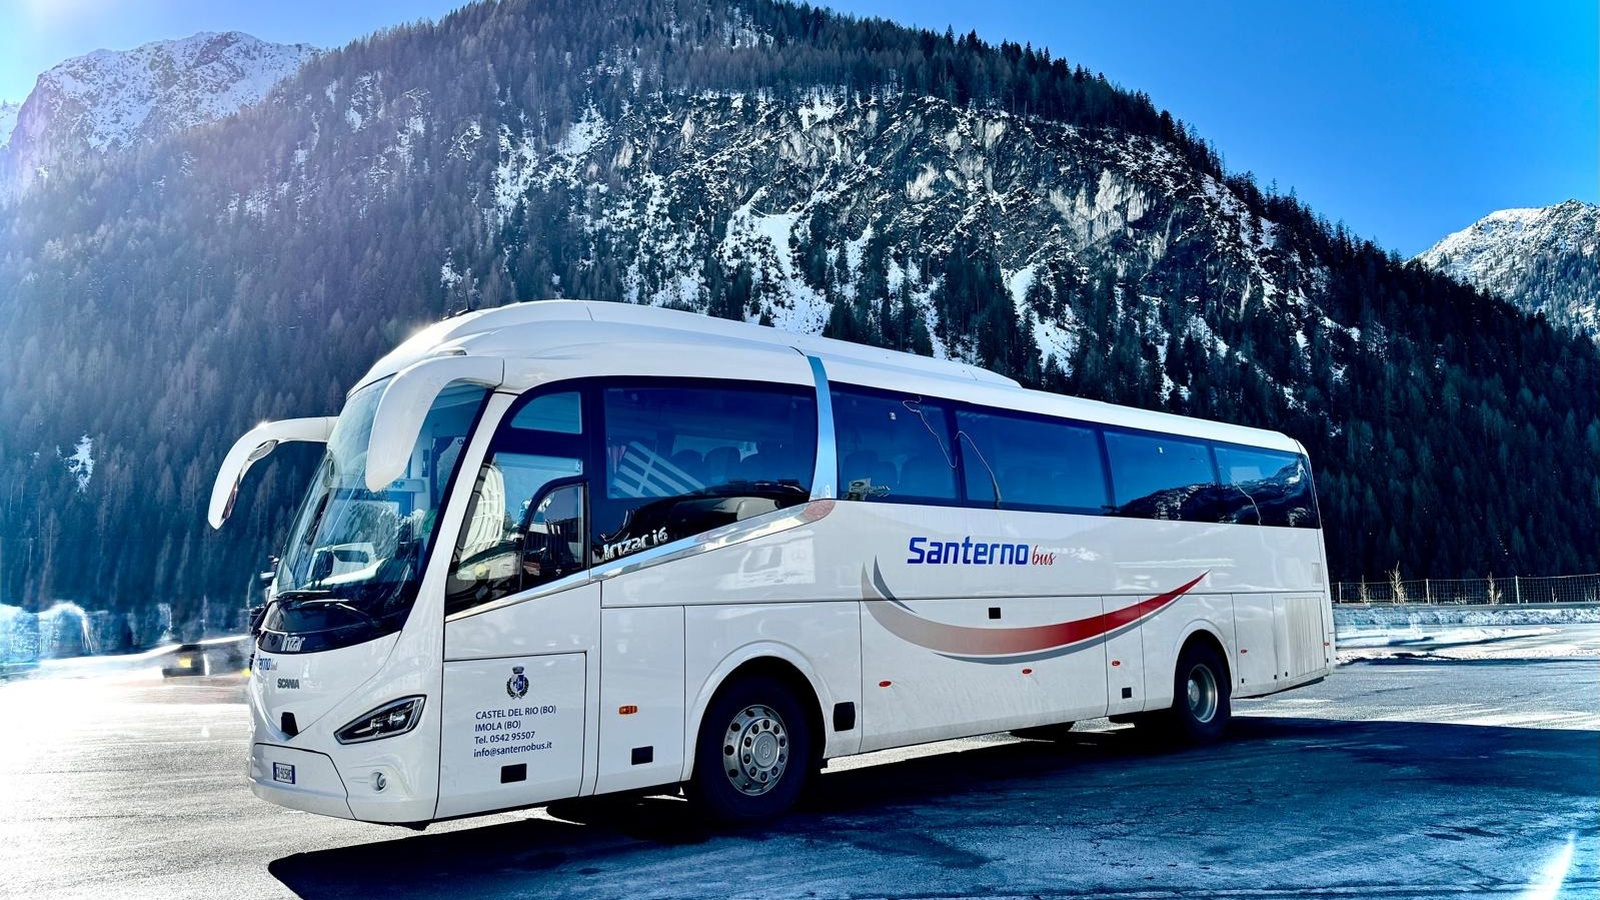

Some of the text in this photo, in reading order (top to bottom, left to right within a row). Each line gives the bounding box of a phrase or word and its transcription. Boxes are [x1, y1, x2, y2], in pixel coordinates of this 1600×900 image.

[603, 526, 668, 560] Irizar i6
[907, 536, 1056, 565] Santerno bus
[277, 678, 300, 689] SCANIA
[475, 705, 557, 720] CASTEL DEL RIO (BO)
[475, 720, 521, 732] IMOLA (BO)
[475, 731, 536, 744] Tel. 0542 95507
[473, 741, 552, 758] info@santernobus.it
